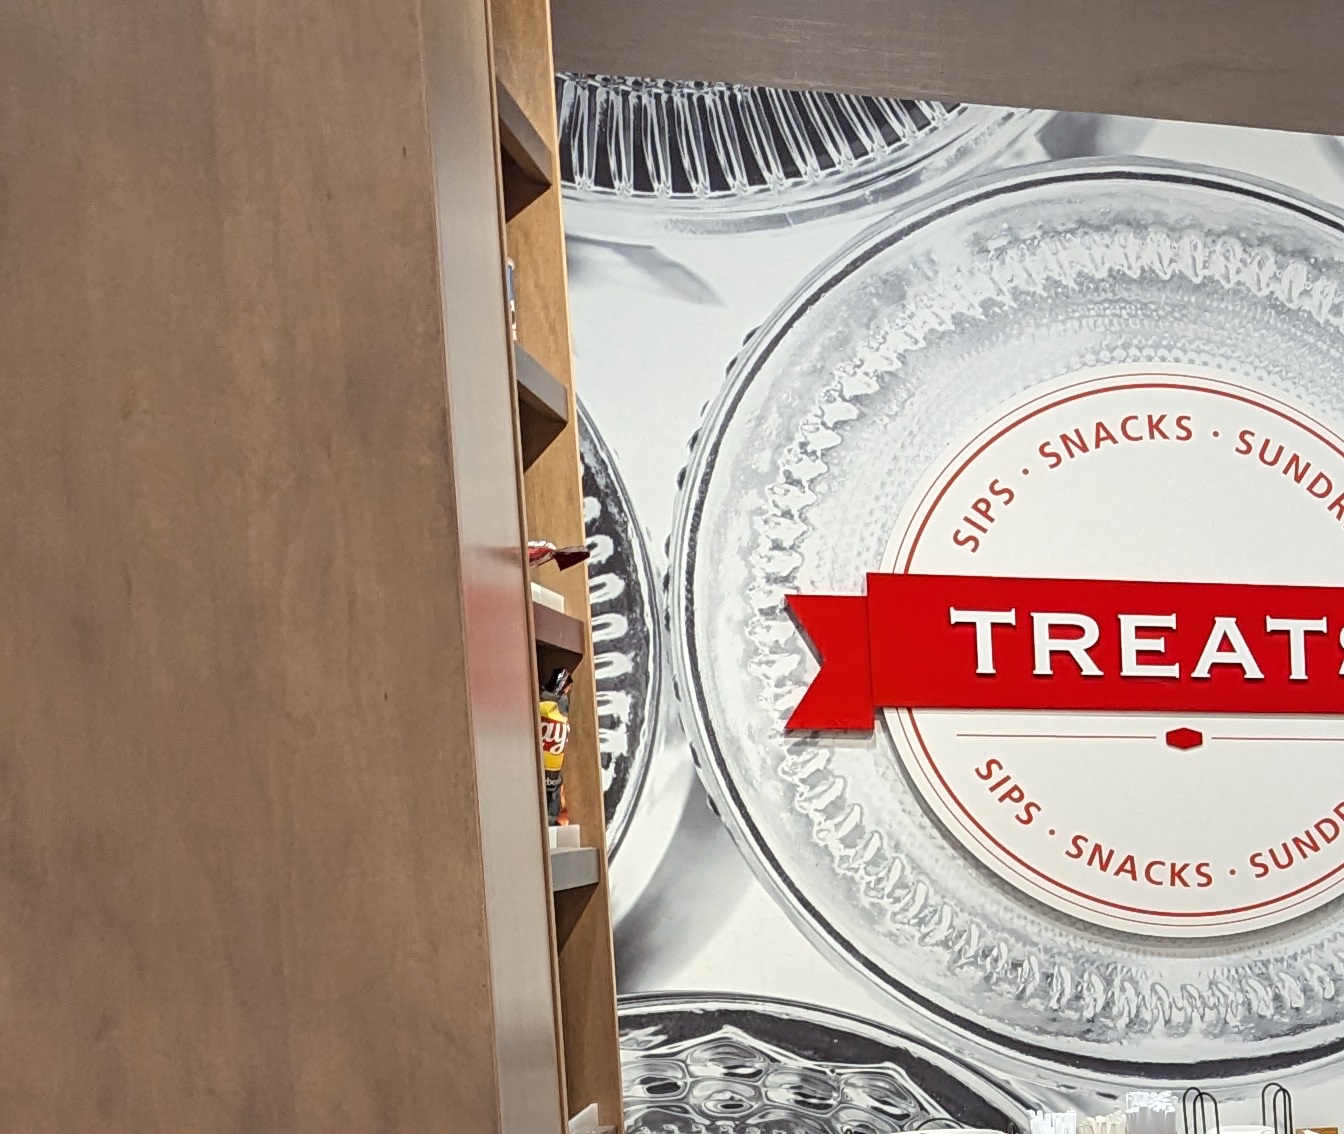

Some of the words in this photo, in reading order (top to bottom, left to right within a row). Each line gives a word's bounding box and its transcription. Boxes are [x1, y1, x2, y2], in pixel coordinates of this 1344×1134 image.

[953, 479, 1015, 554] SIPS
[1039, 415, 1192, 470] SNACKS
[974, 758, 1042, 826] SIPS
[1064, 834, 1213, 889] SNACKS
